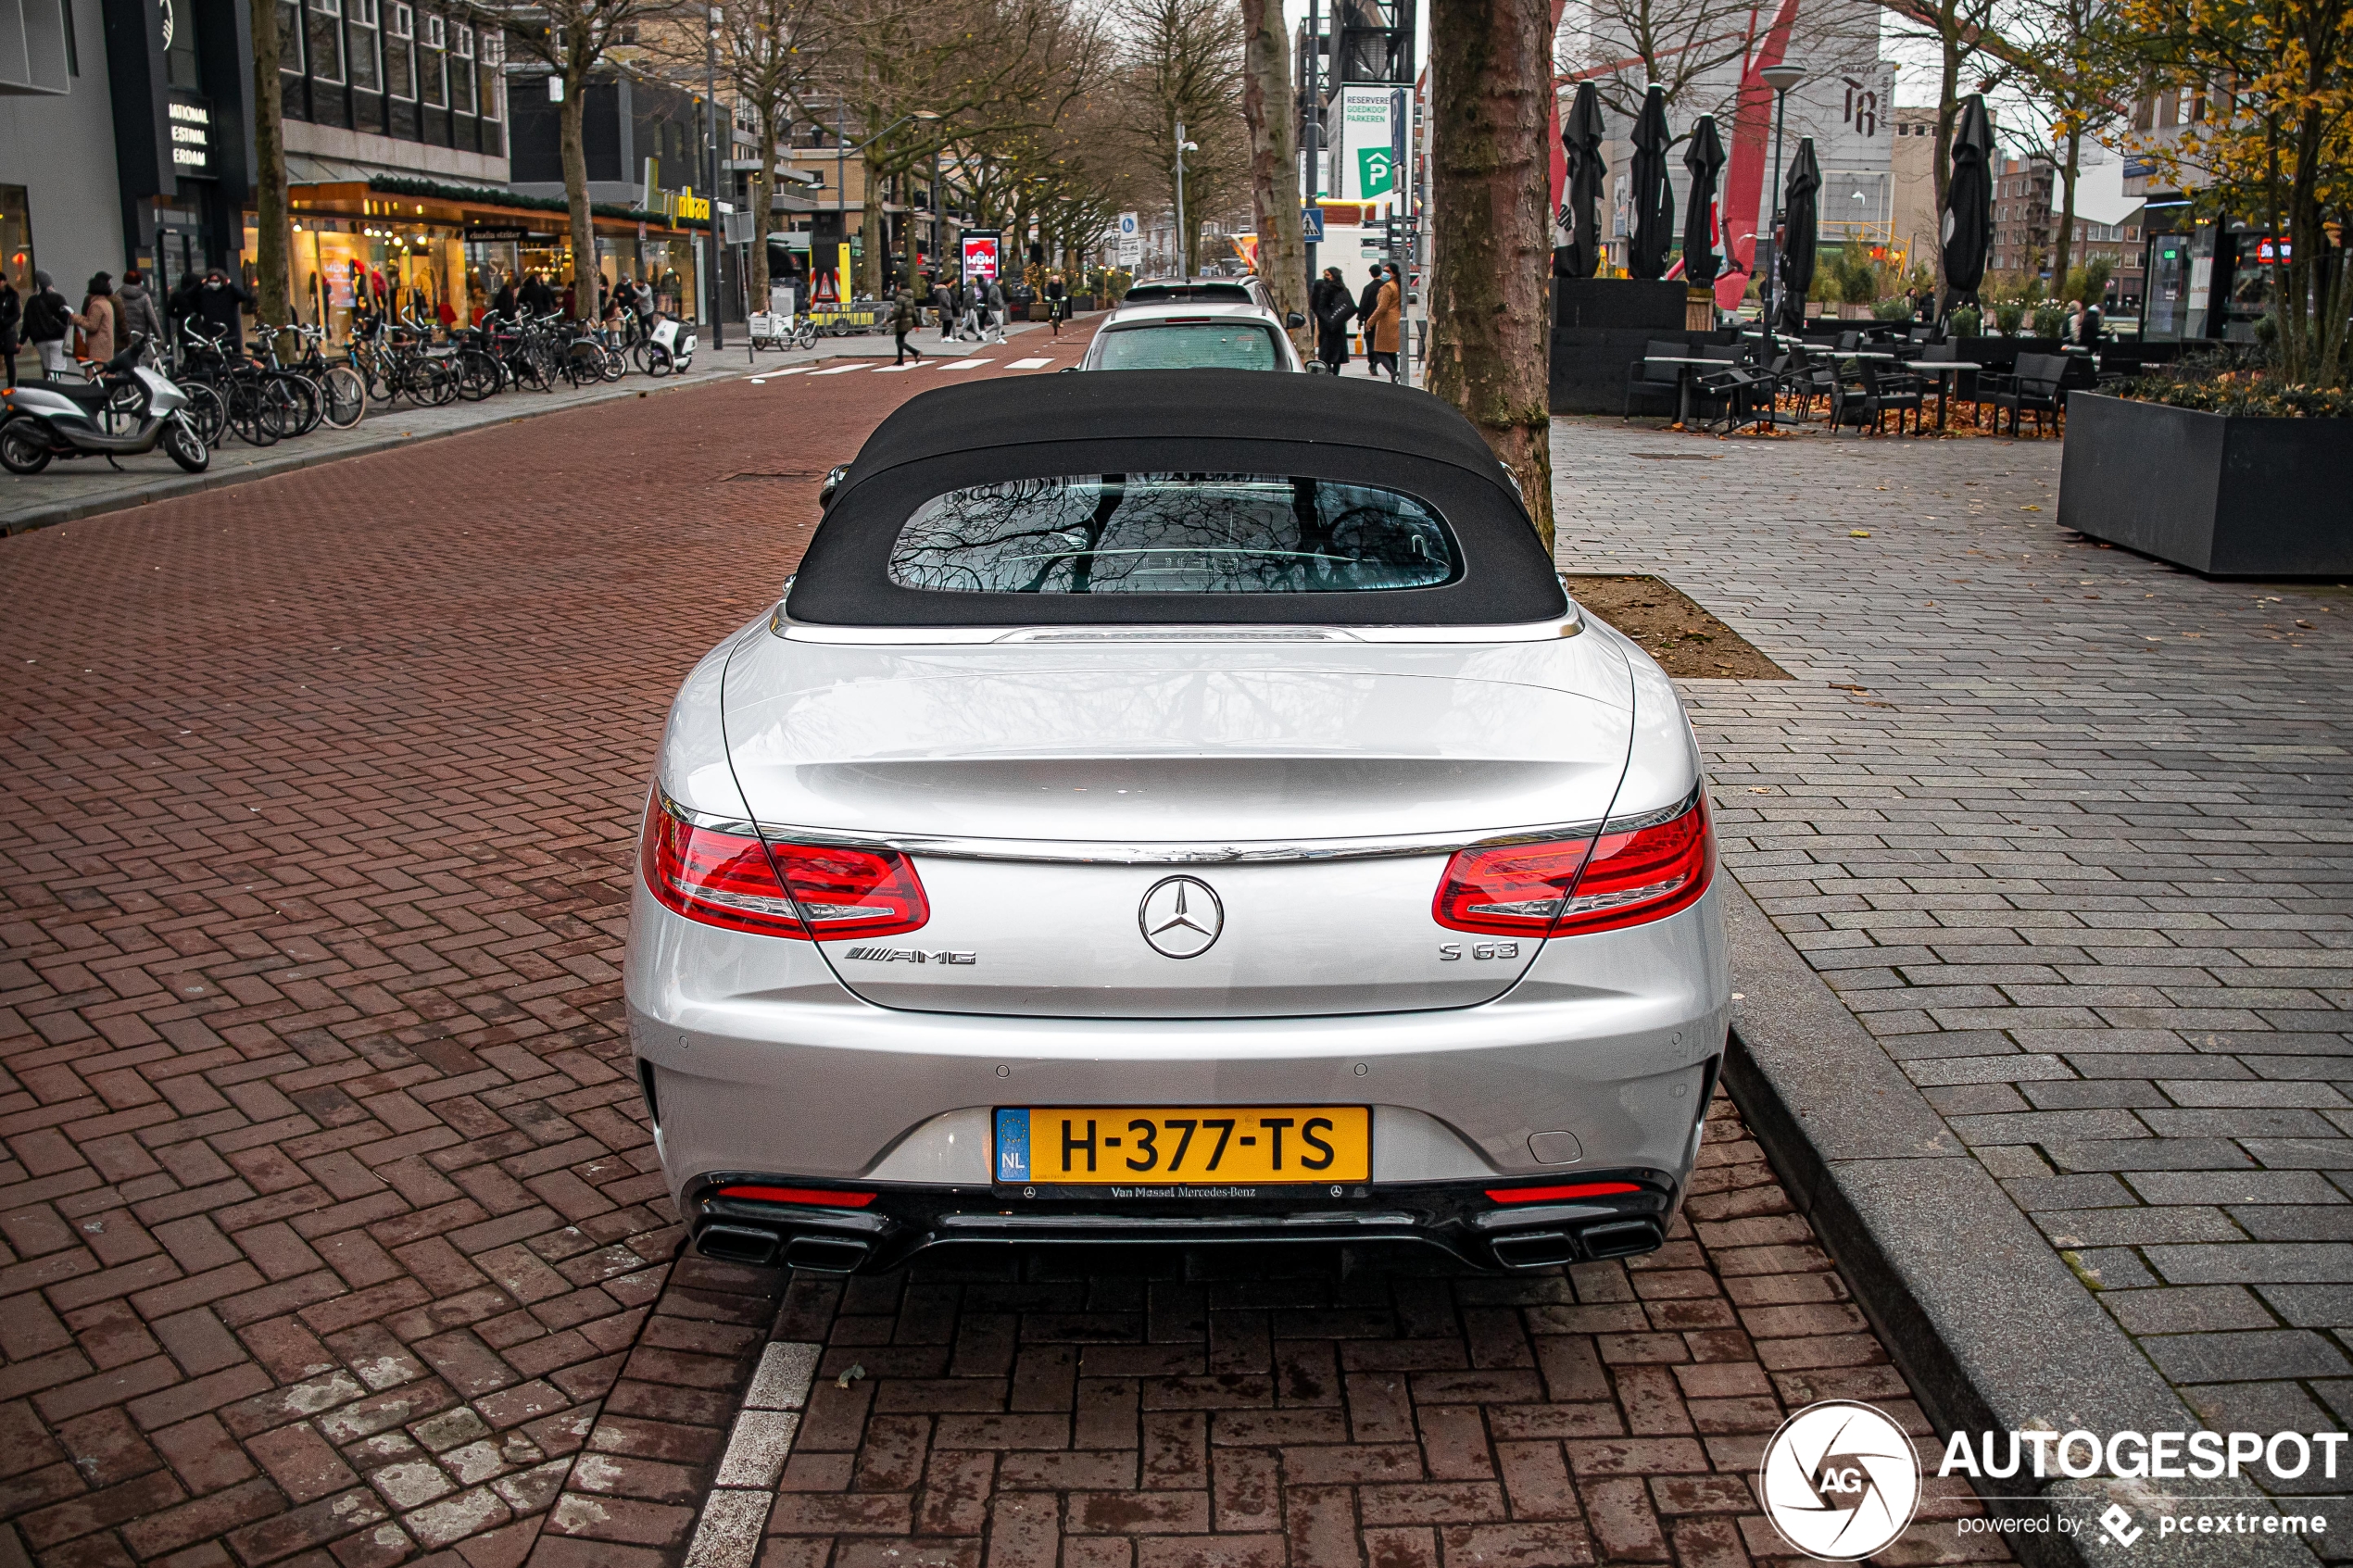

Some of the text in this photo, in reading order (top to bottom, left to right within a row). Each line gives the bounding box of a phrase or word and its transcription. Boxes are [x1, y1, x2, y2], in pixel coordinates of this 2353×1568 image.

[1347, 95, 1390, 105] RESERVERE
[1347, 105, 1388, 113] GOEDKOOP
[1347, 114, 1386, 123] PARKEREN
[172, 125, 208, 144] ESTIVAL
[173, 148, 206, 166] ERDAM
[470, 230, 496, 239] claudia
[1440, 940, 1519, 960] S 63
[1061, 1117, 1336, 1172] H-377-TS
[1001, 1151, 1026, 1170] NL
[1111, 1186, 1256, 1198] Van Mossel Mercedes-Benz
